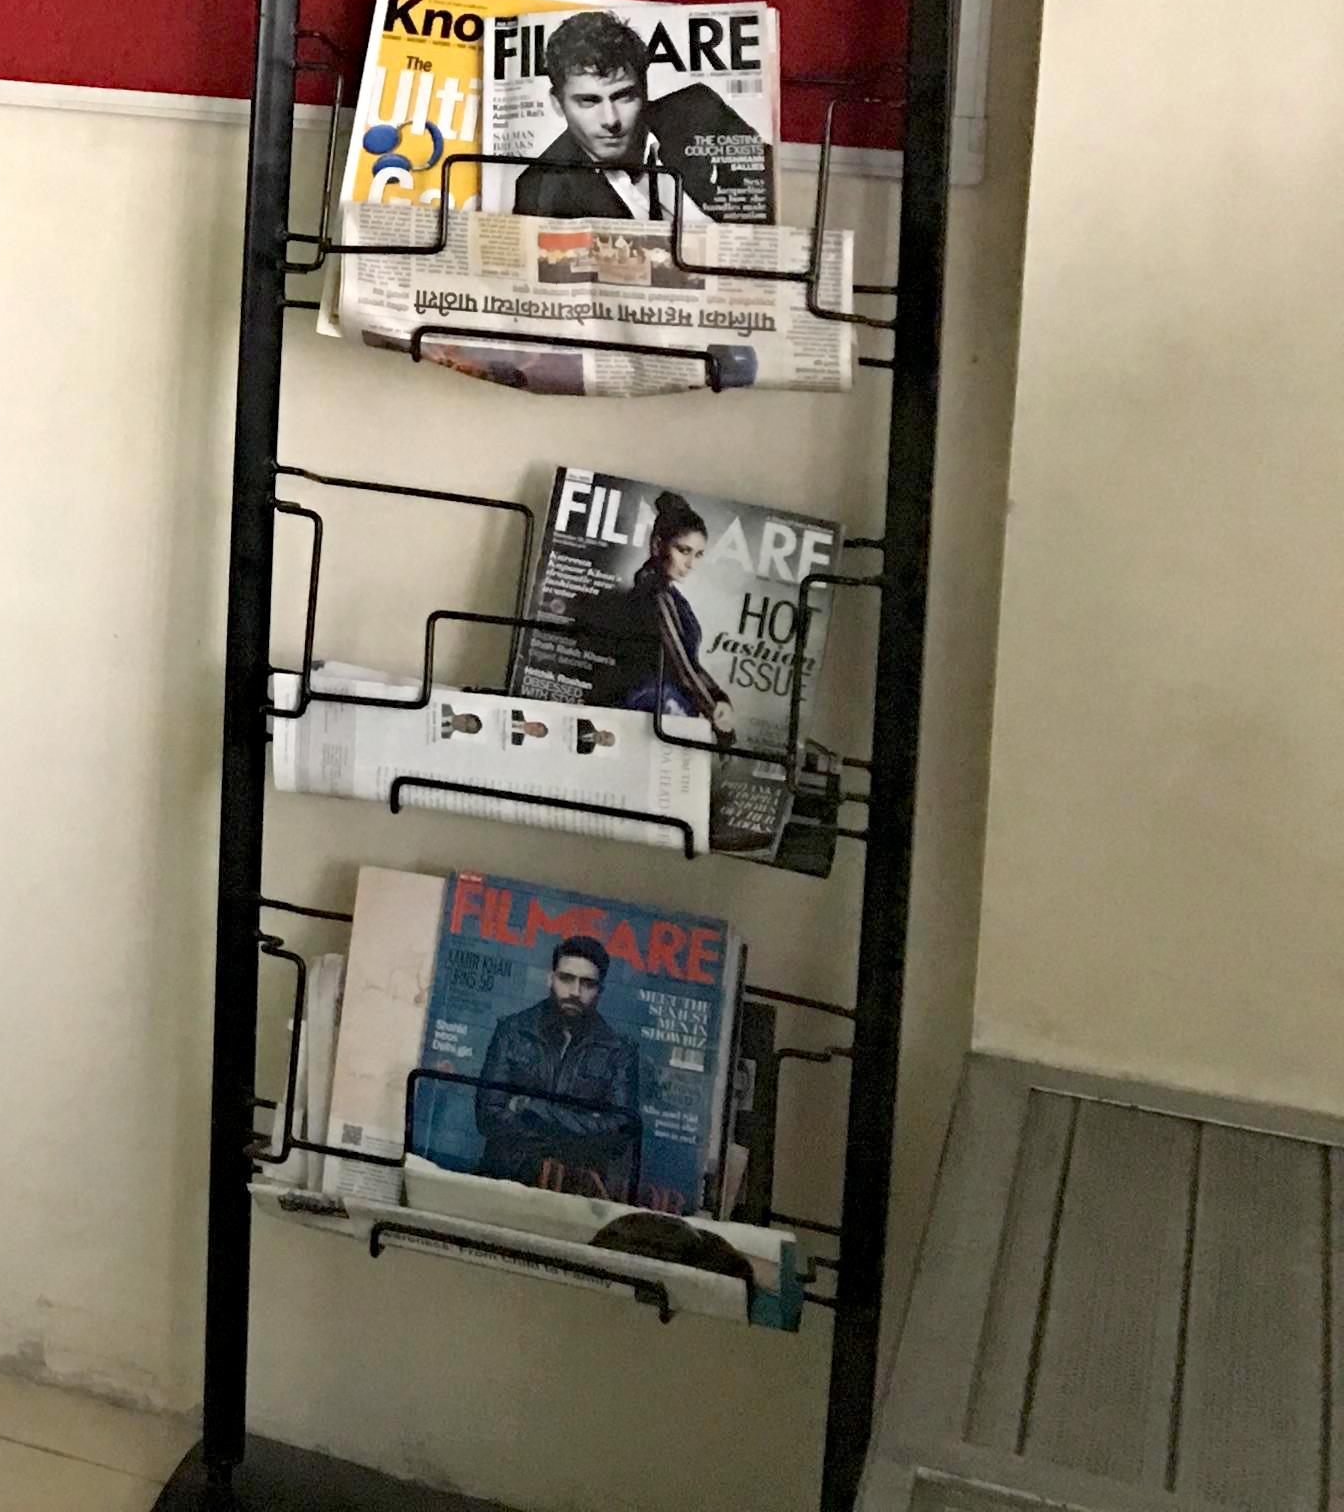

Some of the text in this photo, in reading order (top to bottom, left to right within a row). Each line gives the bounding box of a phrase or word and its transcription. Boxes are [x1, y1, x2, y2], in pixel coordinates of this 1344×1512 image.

[493, 14, 763, 82] FILARE
[406, 55, 433, 73] The
[367, 66, 481, 143] Ulti
[684, 145, 765, 157] COUCH EXISTS
[694, 134, 762, 145] THE CASTING
[617, 301, 694, 328] महासभा
[698, 308, 777, 337] पालिका
